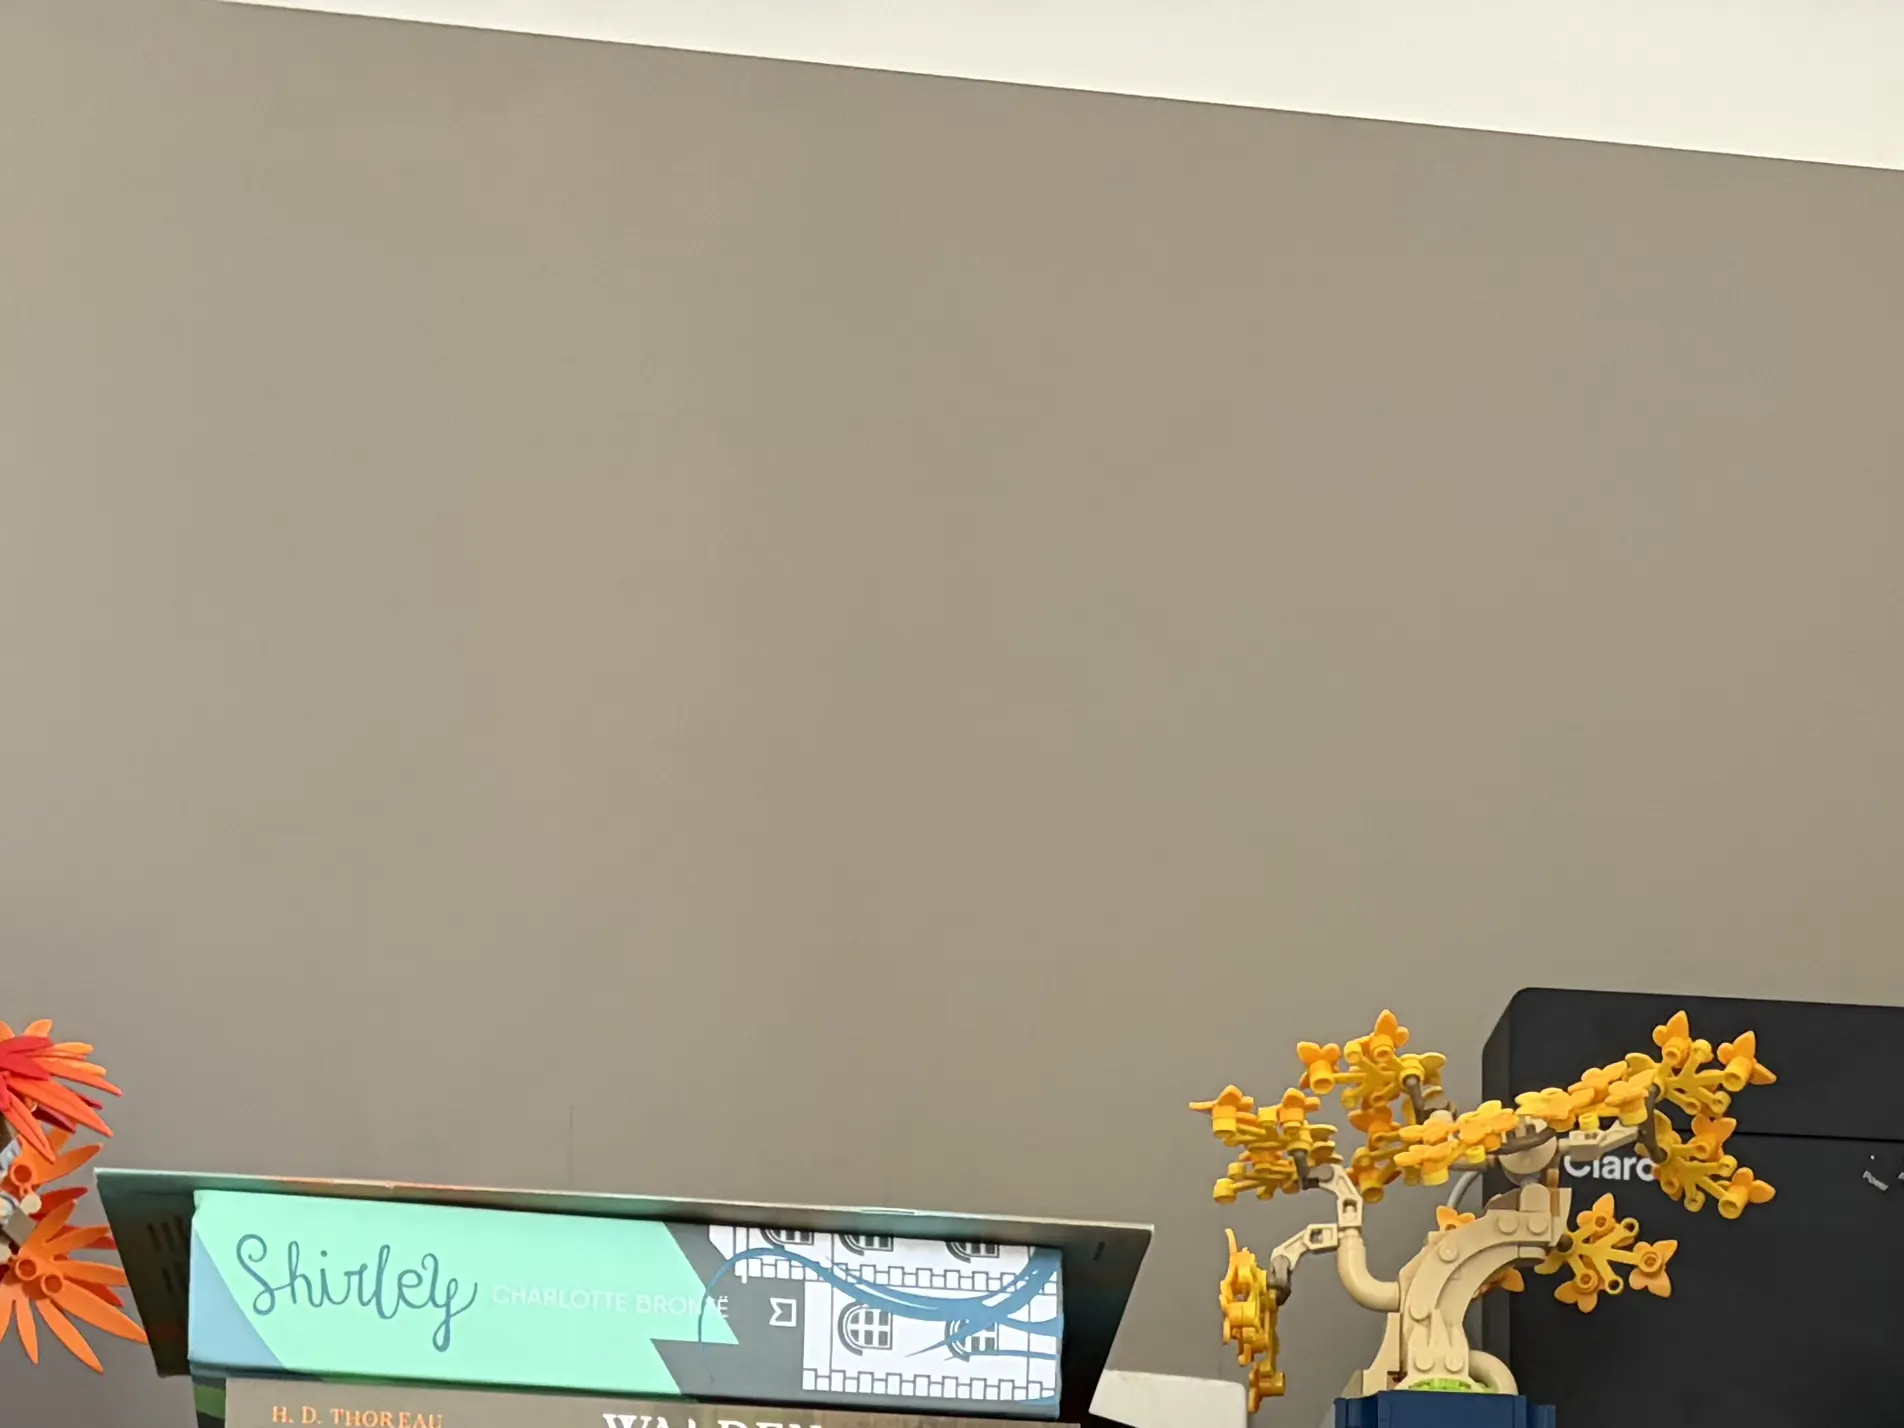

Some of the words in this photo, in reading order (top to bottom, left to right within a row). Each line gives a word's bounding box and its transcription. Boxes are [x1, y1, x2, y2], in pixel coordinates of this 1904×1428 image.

[236, 1233, 478, 1353] Shirley
[492, 1284, 629, 1312] CHARLOTTE
[272, 1406, 294, 1424] H.
[301, 1406, 324, 1425] D.
